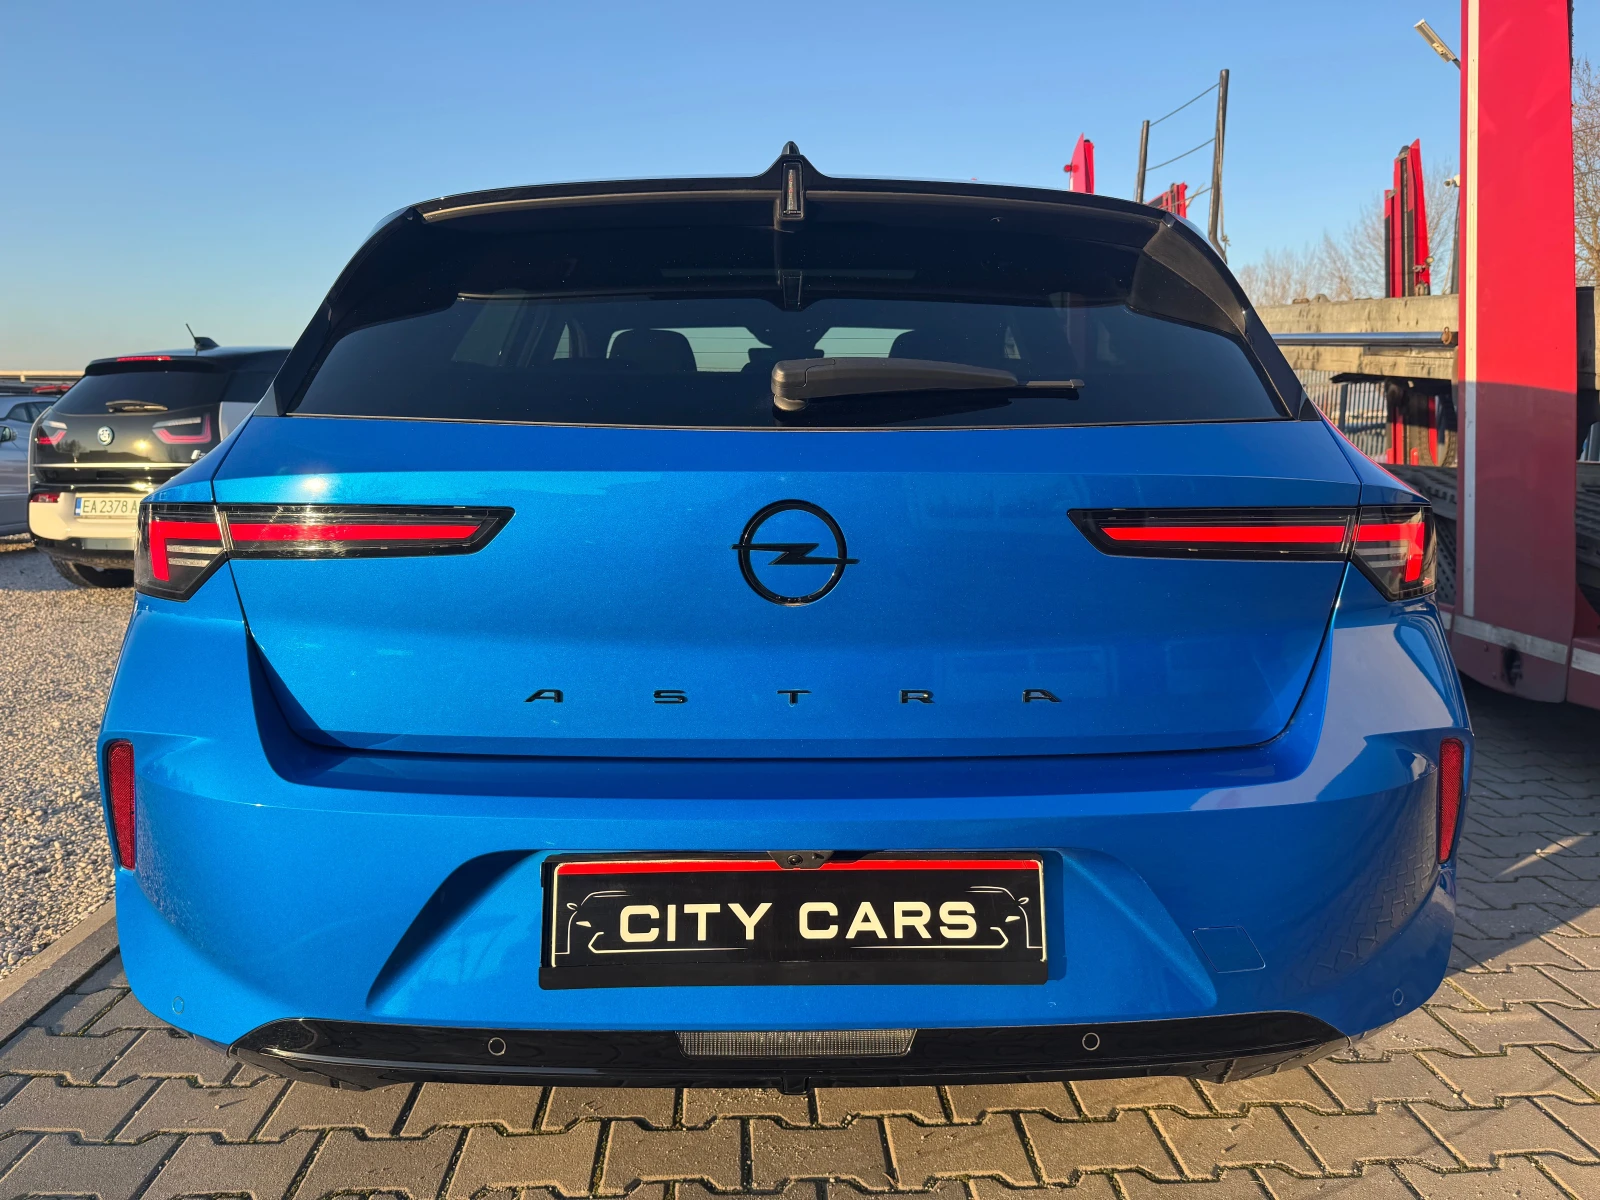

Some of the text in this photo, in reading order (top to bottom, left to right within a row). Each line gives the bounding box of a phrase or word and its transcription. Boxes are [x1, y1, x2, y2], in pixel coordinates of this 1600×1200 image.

[83, 499, 97, 513] EA
[99, 499, 128, 513] 2378
[524, 689, 1062, 704] ASTRA
[619, 901, 977, 943] CITY CARS
